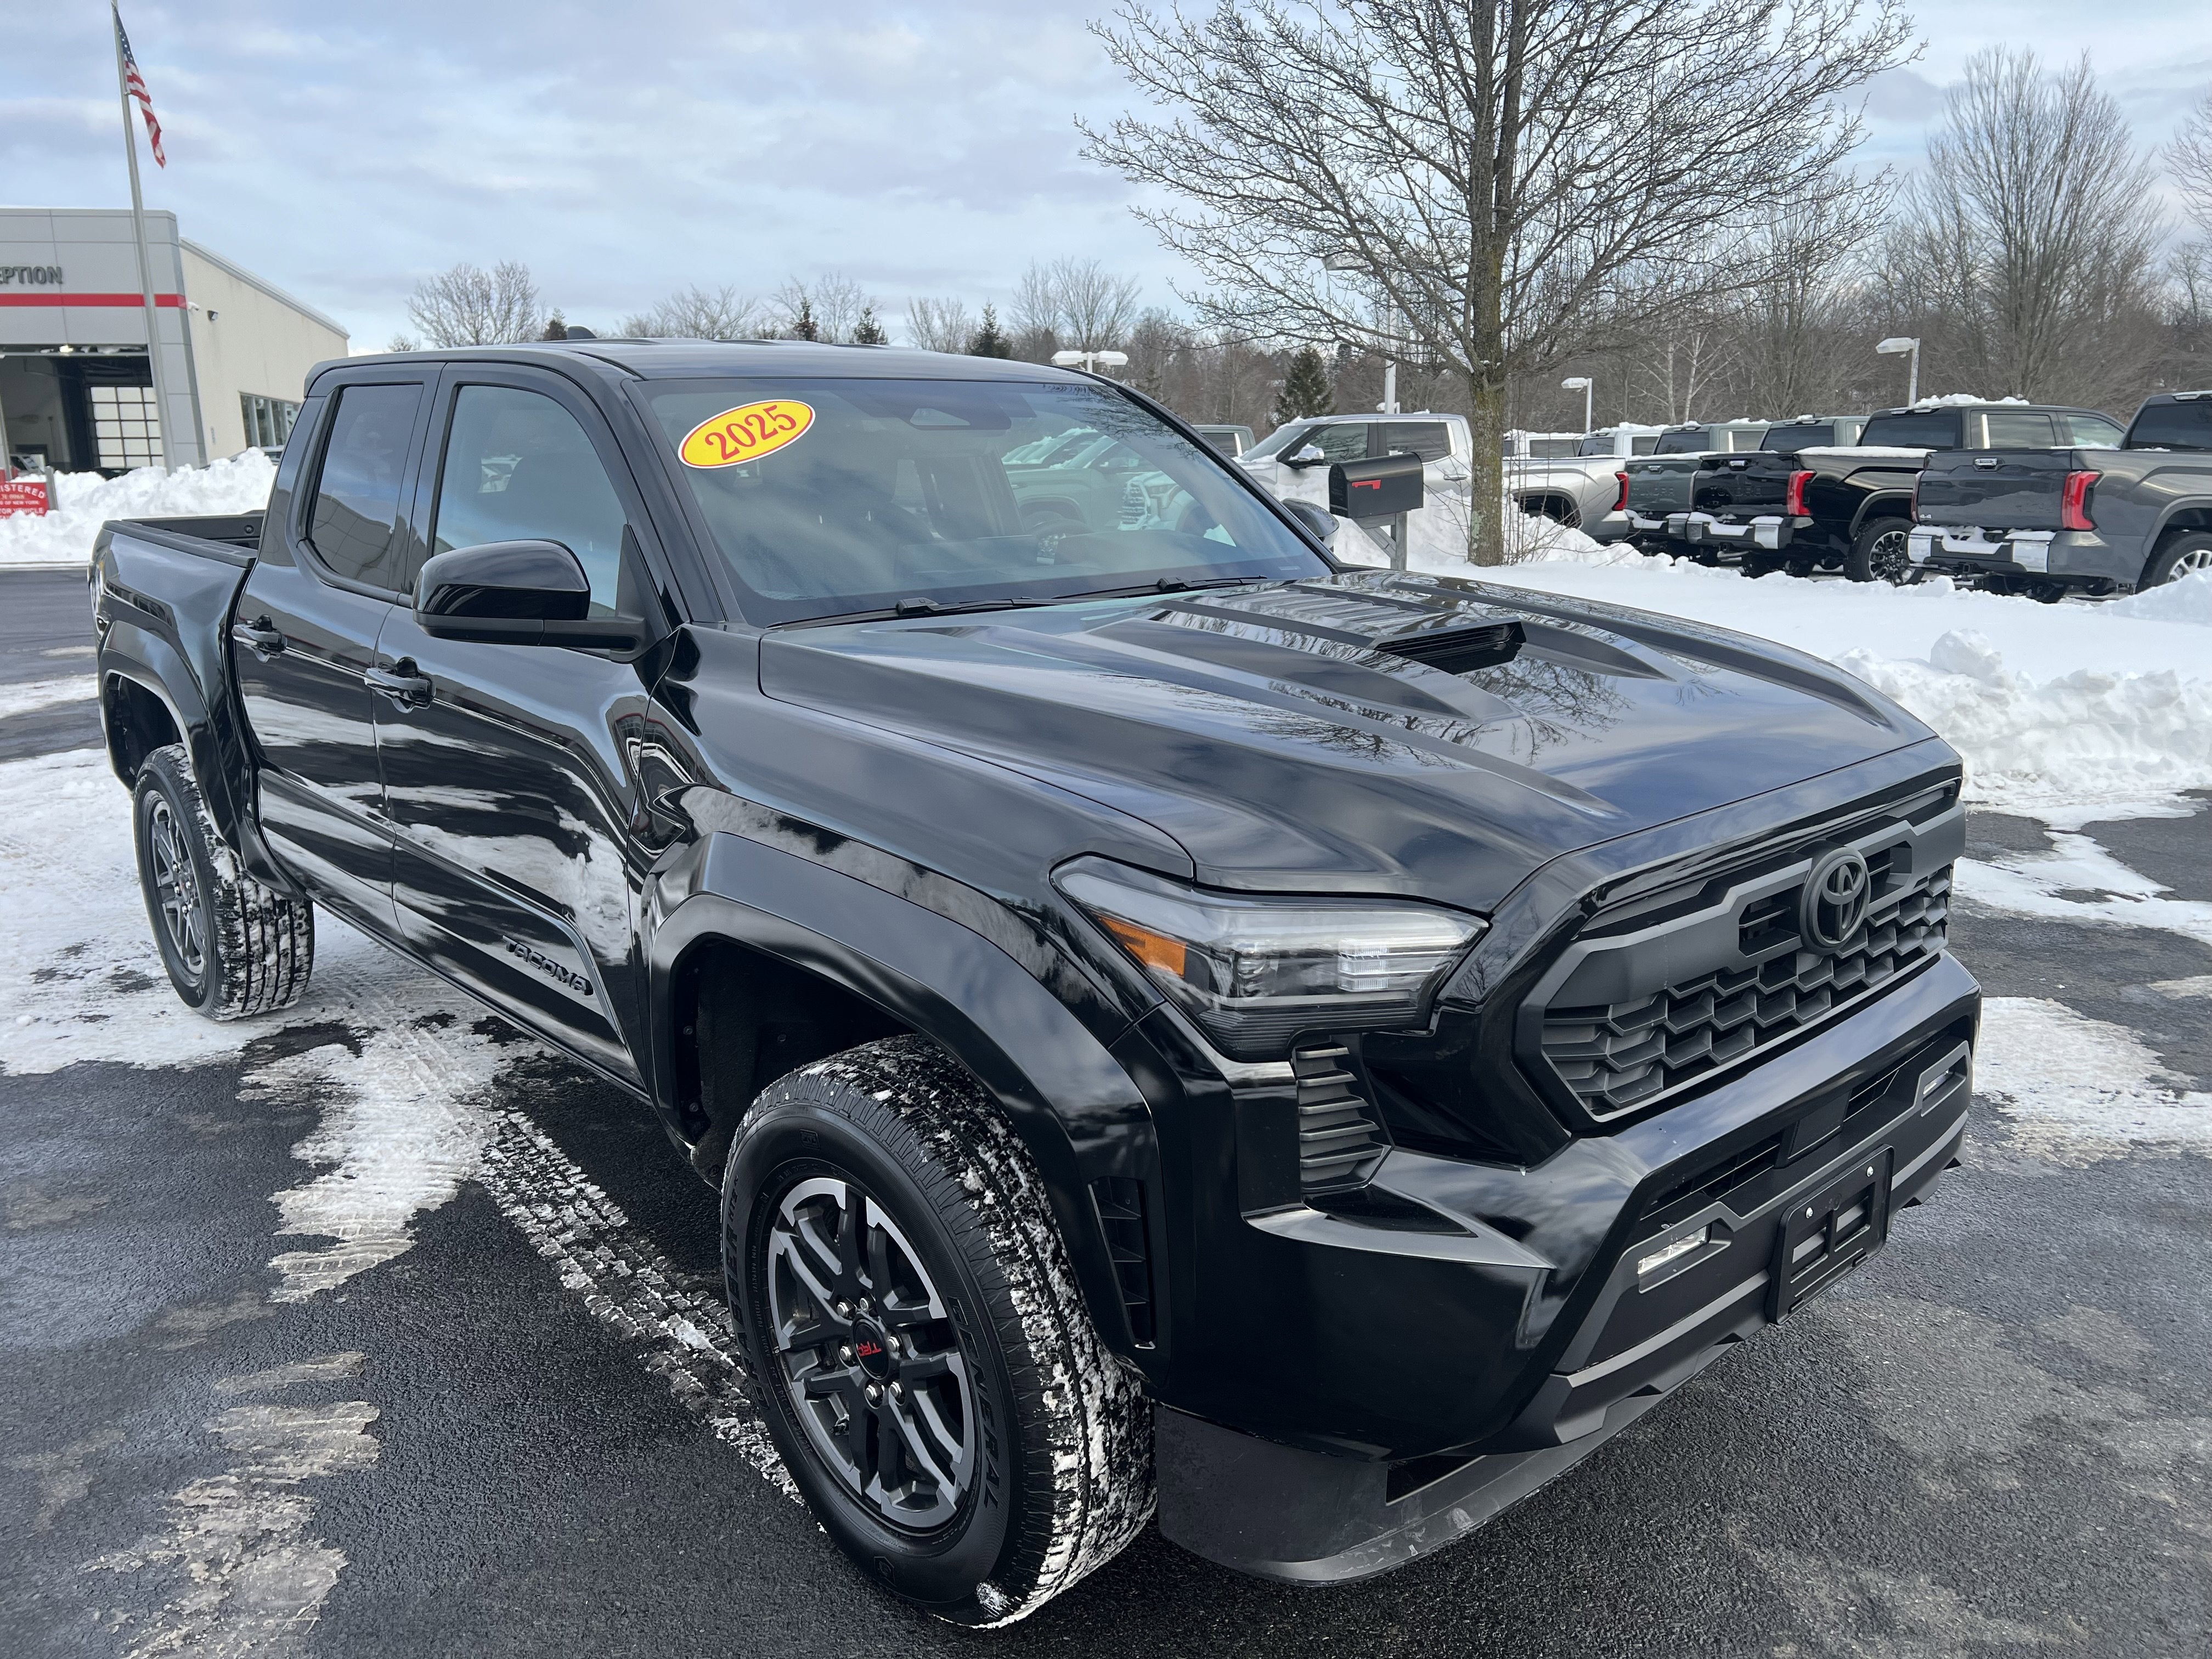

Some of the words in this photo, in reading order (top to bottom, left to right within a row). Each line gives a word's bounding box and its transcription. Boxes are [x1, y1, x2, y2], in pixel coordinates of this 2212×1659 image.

[705, 405, 796, 460] 2025
[502, 935, 594, 996] TACOMA
[725, 1223, 769, 1409] GRABBER
[856, 1341, 882, 1357] TRD
[947, 1296, 1000, 1509] GENERAL
